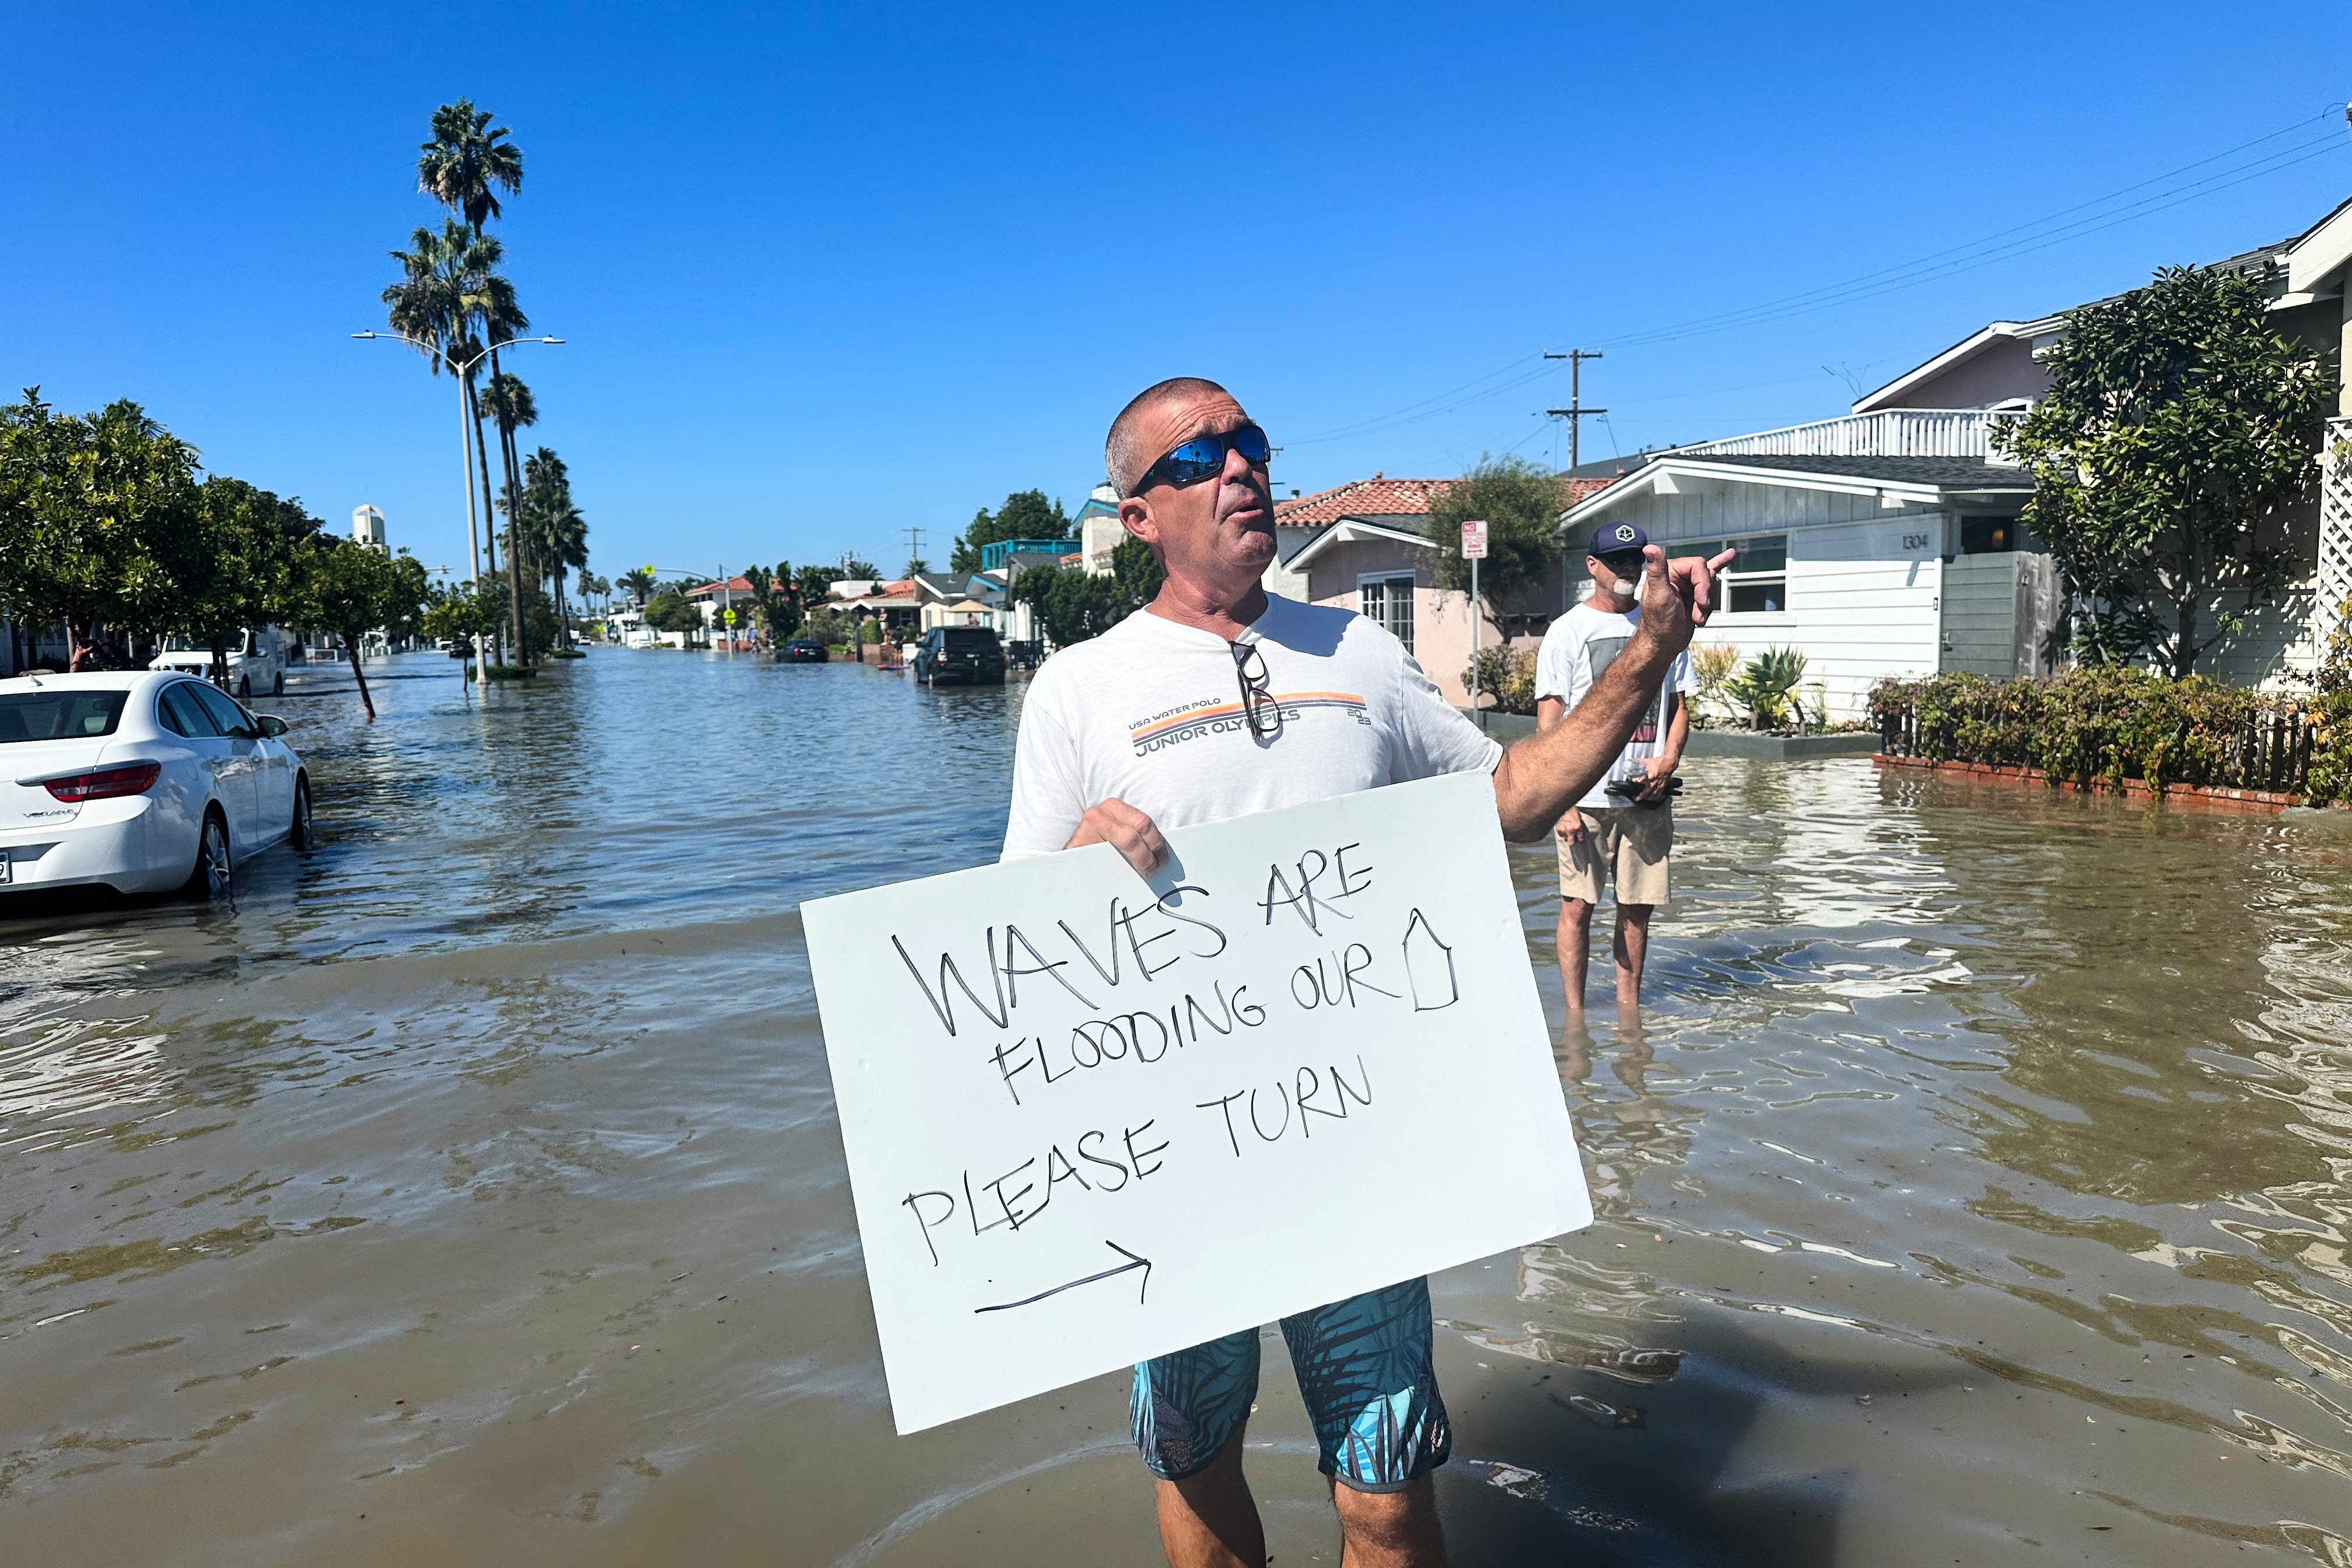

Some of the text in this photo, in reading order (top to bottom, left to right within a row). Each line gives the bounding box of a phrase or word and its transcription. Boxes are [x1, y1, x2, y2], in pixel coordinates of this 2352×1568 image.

[1902, 534, 1929, 550] 1304
[1128, 698, 1221, 730] USA WATER POLO
[1346, 708, 1362, 718] 20
[1135, 727, 1208, 757] JUNIOR
[891, 842, 1373, 1037] WAVES ARE
[988, 943, 1404, 1105] FLOODING OUR
[902, 1054, 1372, 1267] PLEASE TURN
